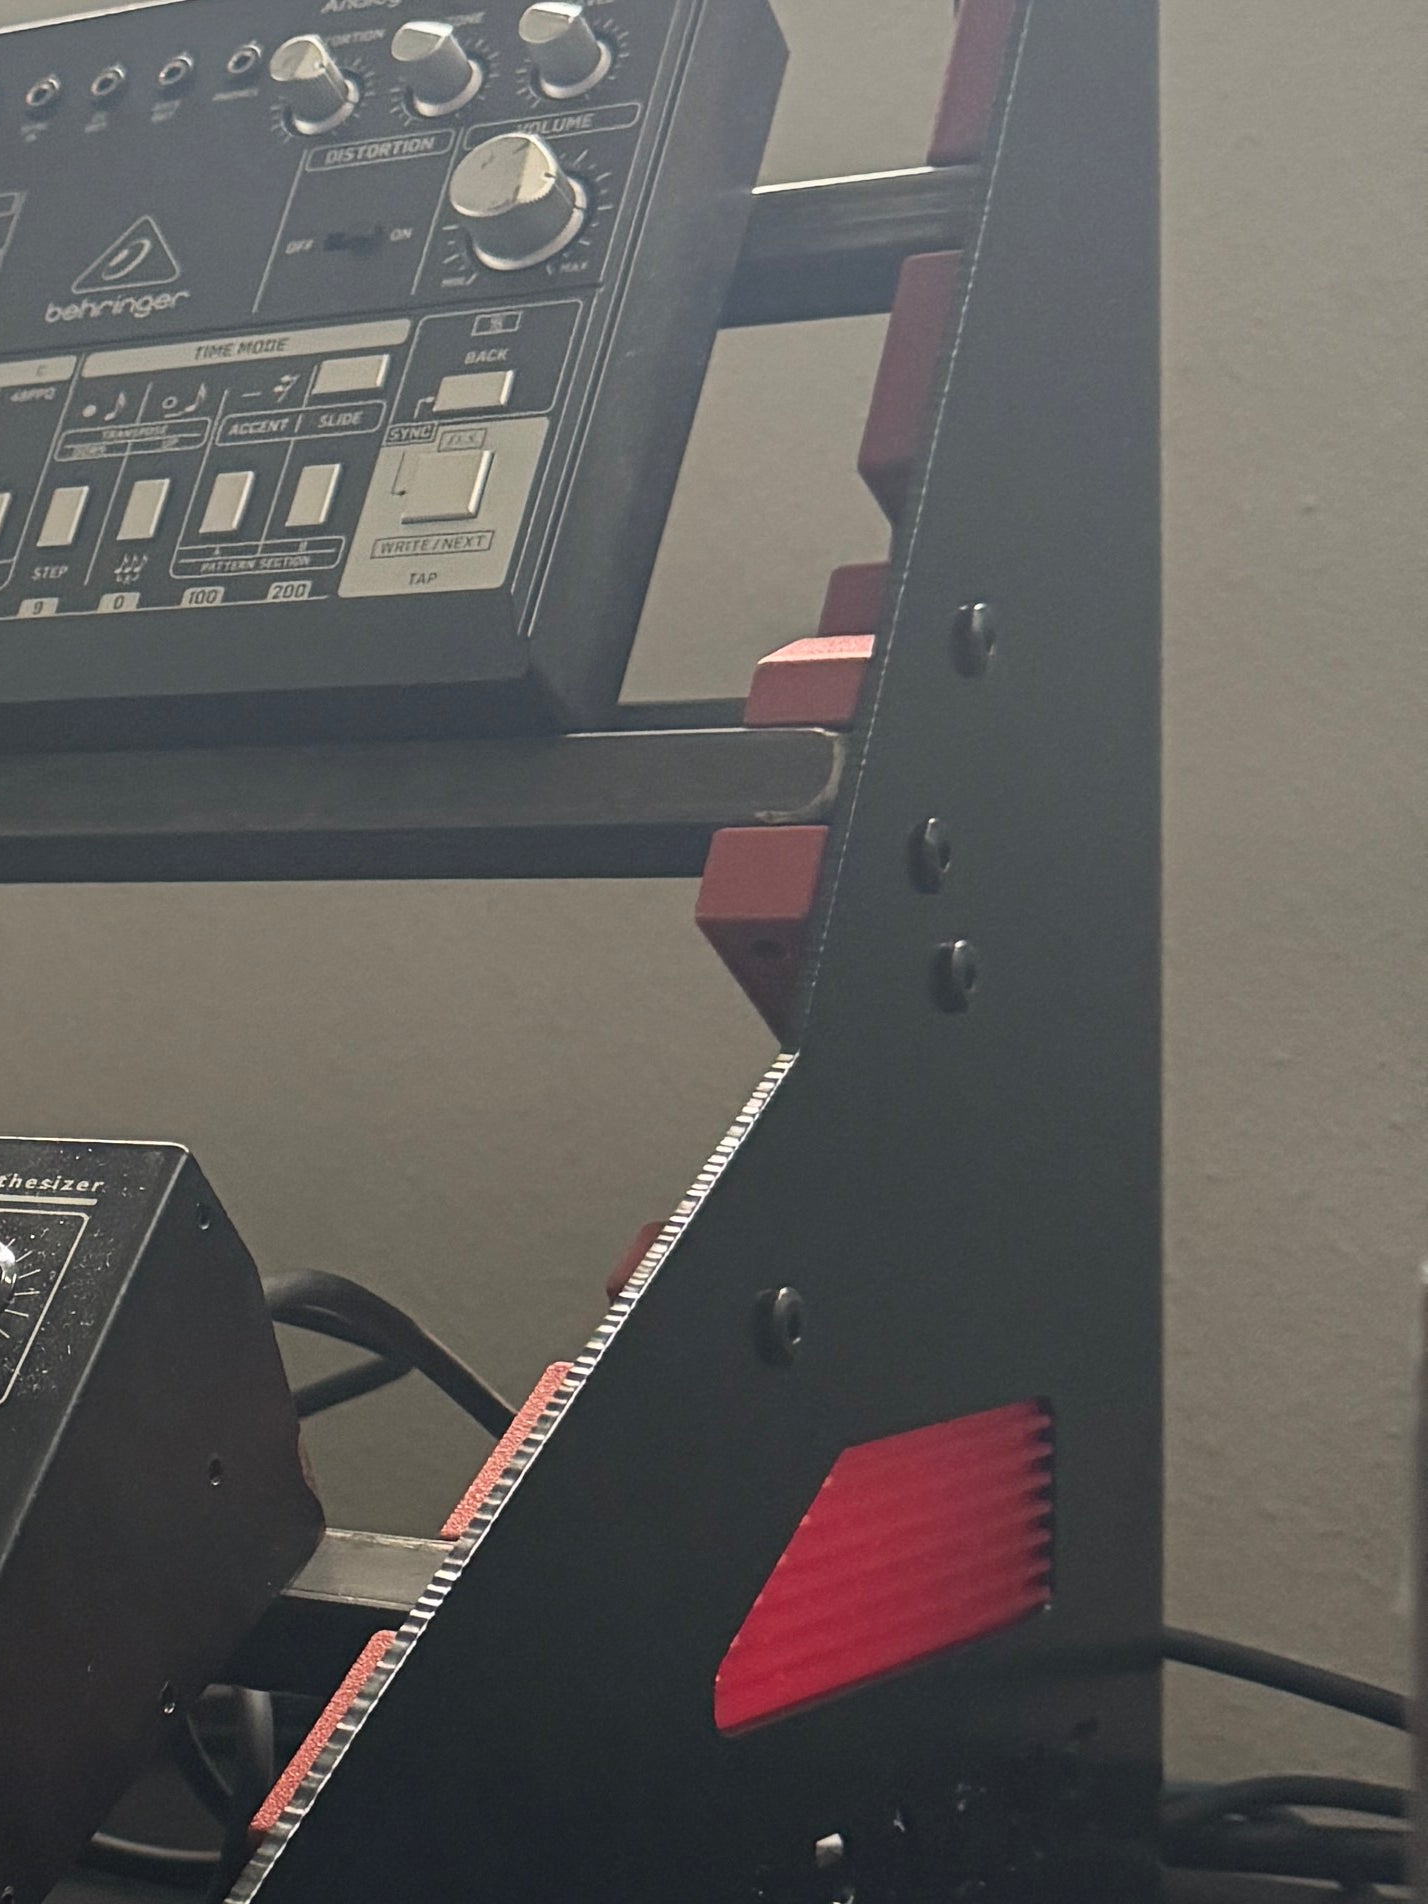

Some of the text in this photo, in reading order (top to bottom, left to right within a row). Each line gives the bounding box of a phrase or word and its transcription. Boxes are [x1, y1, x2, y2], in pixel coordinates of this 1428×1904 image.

[325, 136, 436, 165] DISTORTION
[285, 227, 413, 254] OFF ON
[44, 289, 191, 323] behringer
[195, 336, 290, 361] TIME MODE
[464, 348, 510, 365] BACK
[228, 411, 364, 436] ACCENT SLIDE
[387, 424, 434, 442] SYNC
[379, 534, 488, 555] WRITE/NEXT
[31, 565, 69, 581] STEP
[200, 555, 311, 573] PATTERN SECTION
[408, 572, 439, 586] TAP
[188, 589, 219, 605] 100
[271, 584, 307, 600] 200
